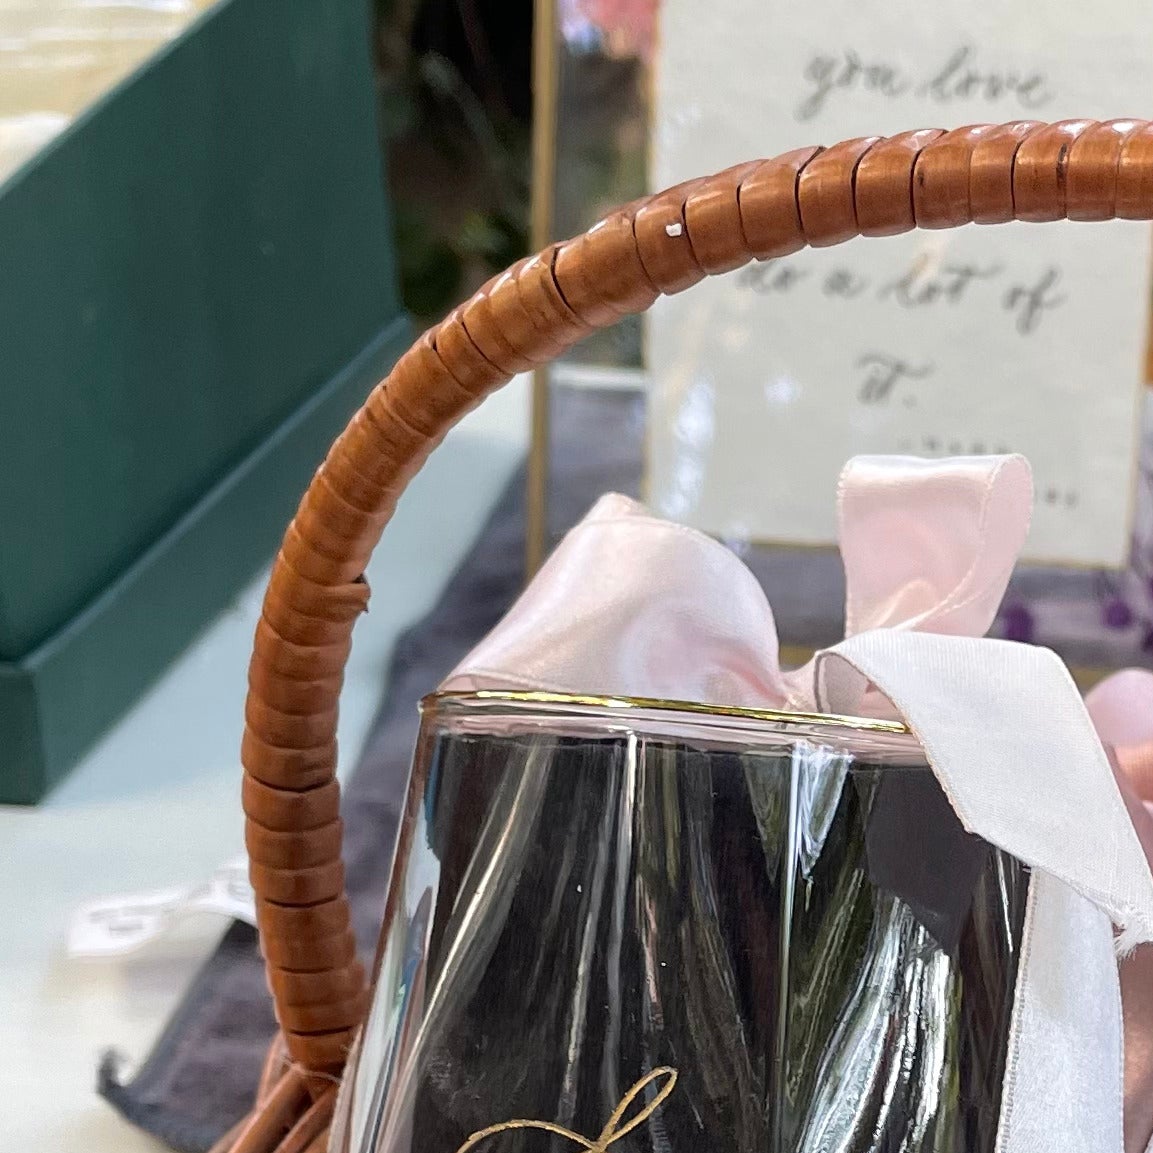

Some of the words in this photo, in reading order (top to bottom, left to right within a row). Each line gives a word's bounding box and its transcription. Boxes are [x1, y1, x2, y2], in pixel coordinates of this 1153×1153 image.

[793, 51, 908, 121] you
[913, 45, 1054, 108] love
[876, 252, 1002, 309] lot
[1002, 264, 1068, 335] of
